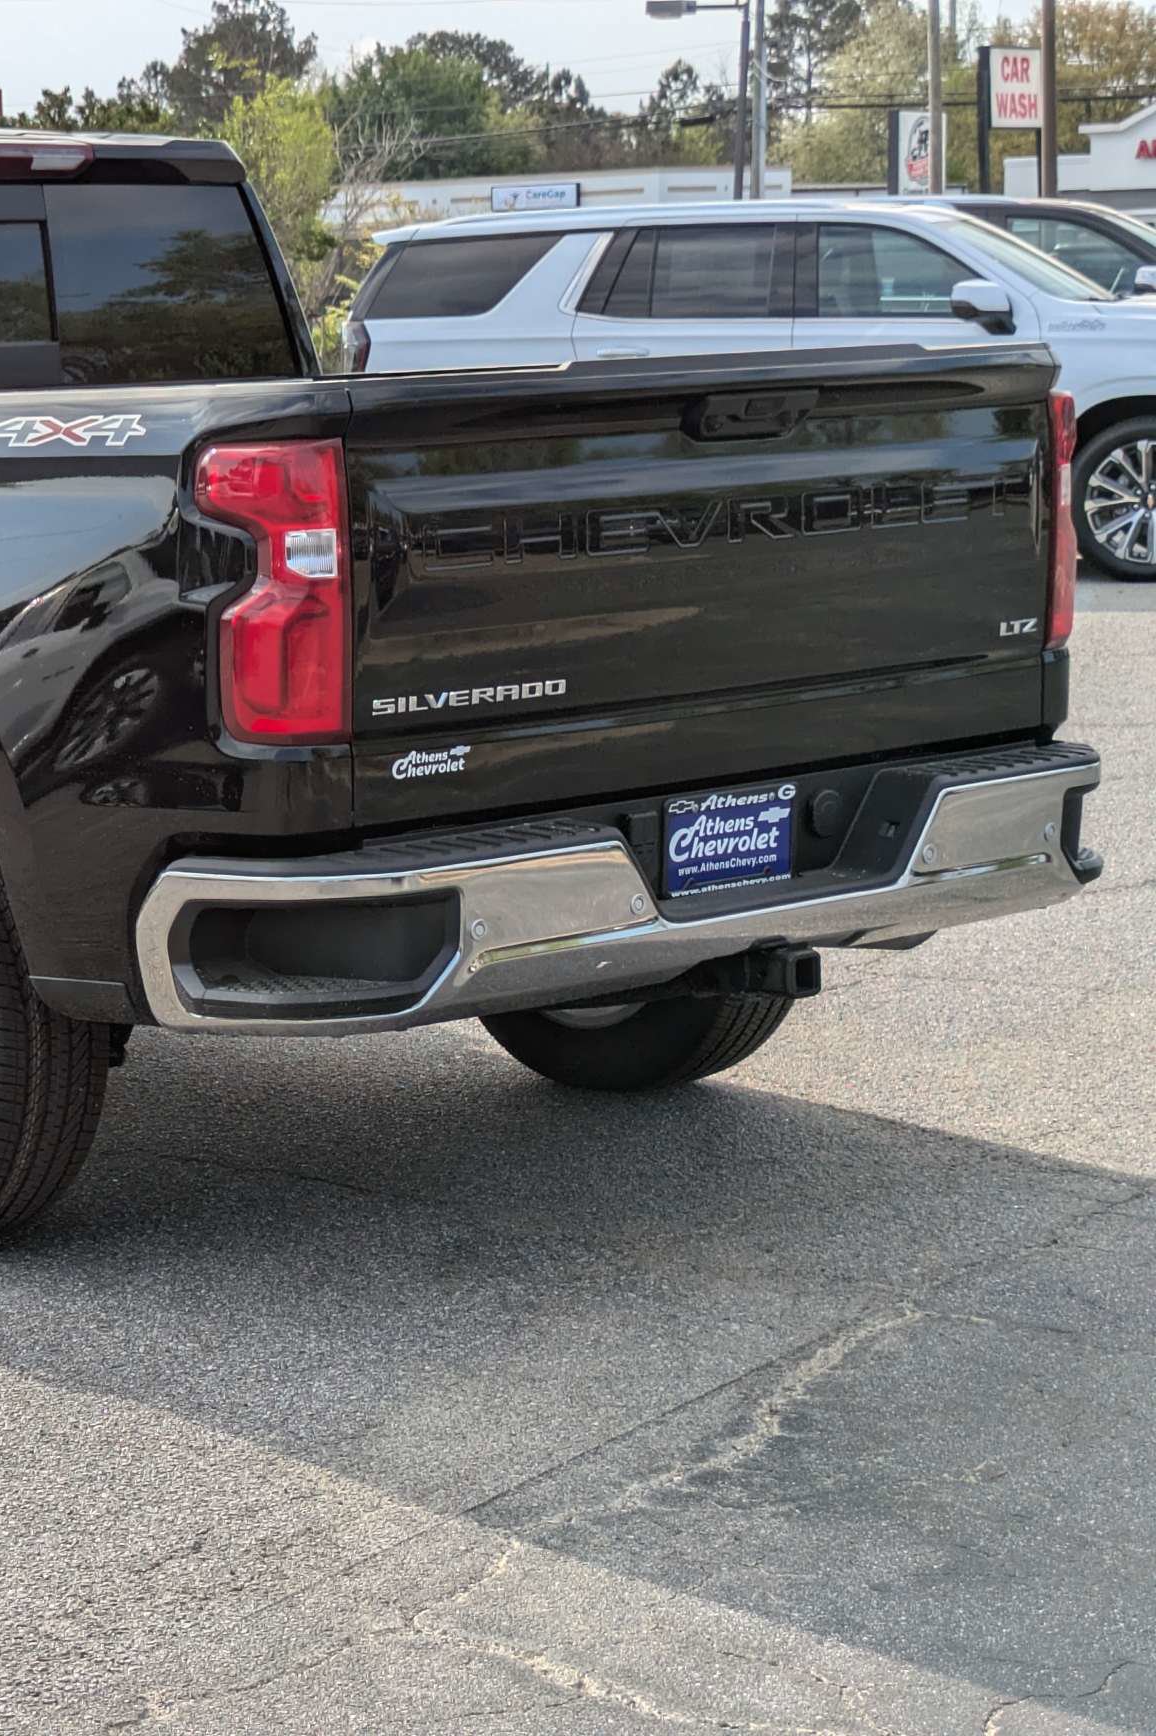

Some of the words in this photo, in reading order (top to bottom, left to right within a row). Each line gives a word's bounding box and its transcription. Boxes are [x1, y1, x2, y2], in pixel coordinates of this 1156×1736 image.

[1001, 56, 1030, 82] CAR
[996, 93, 1038, 119] WASH
[422, 478, 1030, 571] CHEVROLET
[999, 617, 1037, 637] LTZ
[372, 679, 567, 716] SILVERADO
[392, 758, 466, 780] Chevrolet
[404, 750, 449, 765] Athens
[699, 793, 769, 812] Athens
[691, 814, 755, 838] Athens
[669, 825, 780, 863] Chevrolet
[678, 853, 777, 877] www.AthensChevy.com
